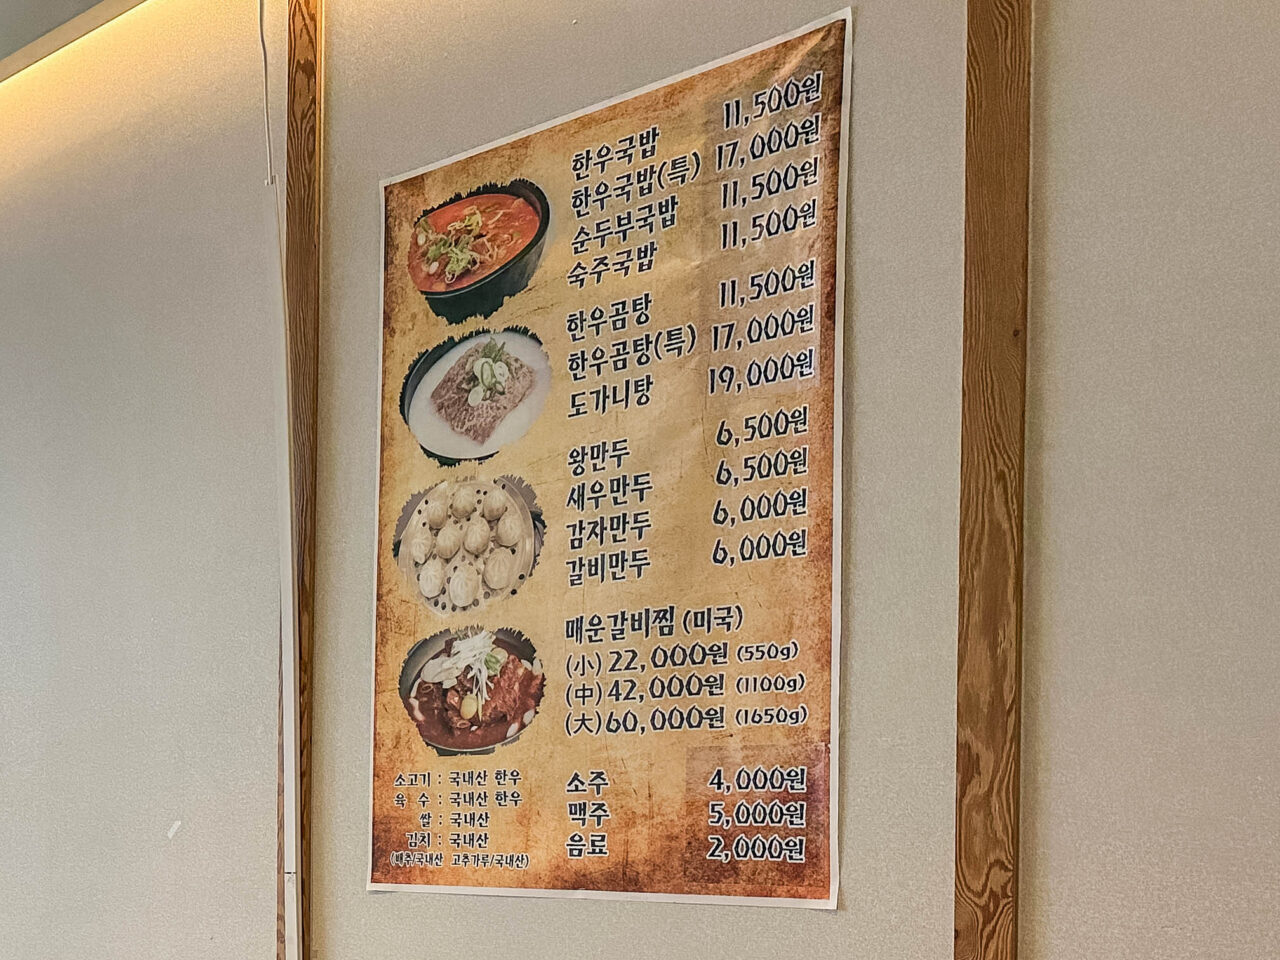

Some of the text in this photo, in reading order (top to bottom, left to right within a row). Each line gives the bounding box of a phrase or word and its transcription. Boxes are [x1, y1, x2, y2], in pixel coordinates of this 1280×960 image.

[572, 72, 822, 181] 한우국밥 11,500원
[571, 114, 820, 218] 한우국밥(특) 17,000원
[571, 156, 818, 255] 순두부국밥 11,500원
[568, 199, 816, 288] 숙주국밥 11,500원
[567, 259, 815, 342] 한우곰탕 11,500원
[568, 304, 814, 381] 한우곰탕(특) 17,000원
[568, 349, 814, 417] 도가니탕 19,000원
[568, 406, 808, 476] 왕만두 6,500원
[567, 447, 808, 512] 새우만두 6,500원
[566, 488, 807, 549] 감자만두 6,000원
[566, 529, 807, 586] 갈비만두 6,000원
[565, 605, 743, 644] 매운갈비찜 (미국)
[566, 640, 799, 678] (小) 22,000원 (550g)
[566, 672, 806, 707] (中) 42,000원 (1100g)
[565, 705, 808, 736] (大) 60,000원 (1650g)
[394, 769, 521, 787] 소고기 국내산 한우
[566, 767, 807, 796] 소주 4,000원
[449, 791, 488, 807] 국내산
[495, 790, 522, 806] 한우
[568, 800, 806, 828] 맥주 5,000원
[420, 812, 490, 828] 쌀 국내산
[406, 832, 489, 848] 김치 국내산
[566, 833, 805, 862] 음료 2,000원
[390, 852, 530, 869] (배추/국내산 고추가루/국내산)
